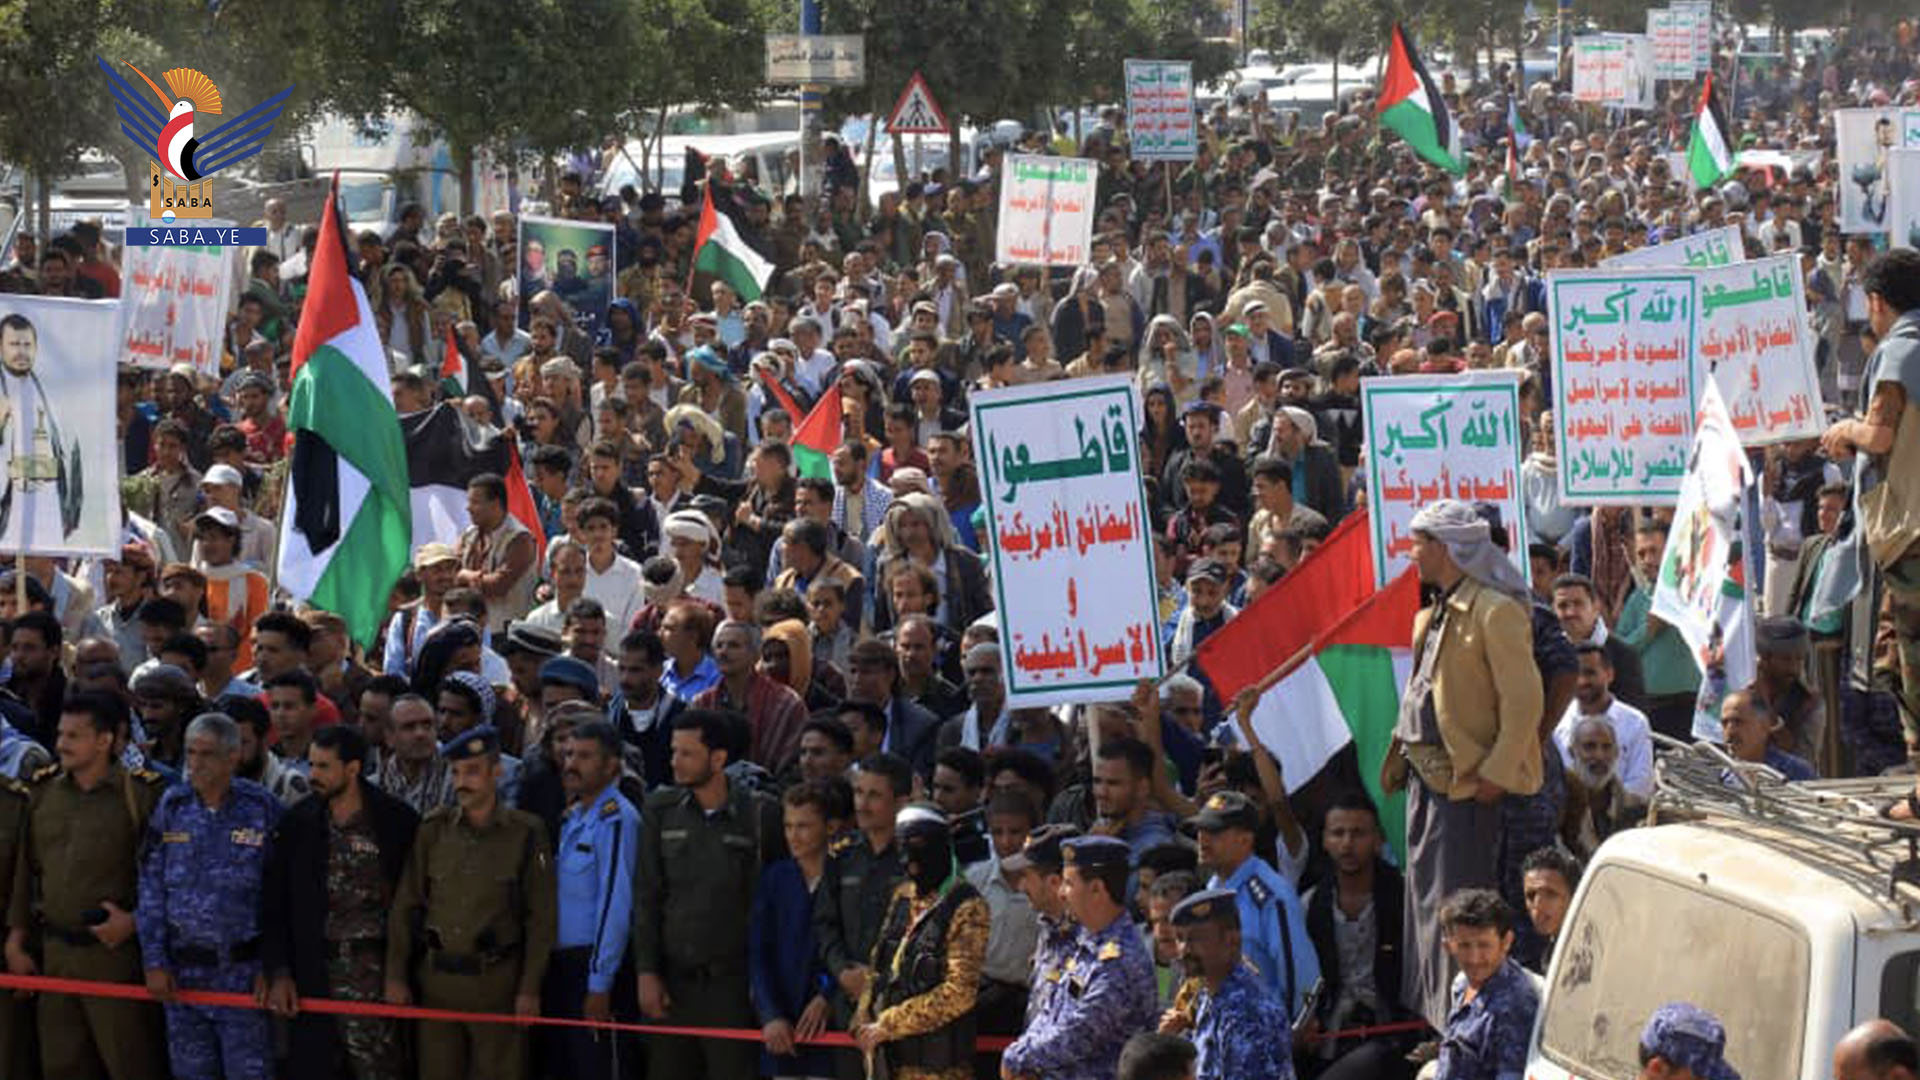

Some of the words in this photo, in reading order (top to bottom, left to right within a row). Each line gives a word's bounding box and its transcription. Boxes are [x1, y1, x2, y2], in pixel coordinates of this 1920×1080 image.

[1684, 242, 1731, 267] قاط
[1563, 283, 1637, 336] أكبر
[1640, 287, 1687, 323] الله
[1702, 265, 1792, 317] قاطعو
[1634, 337, 1685, 365] الموت
[1635, 377, 1686, 404] الموت
[1750, 363, 1759, 391] و
[1380, 394, 1453, 465] أكبر
[1461, 400, 1512, 448] الله
[1567, 411, 1614, 442] اليهود
[1620, 413, 1643, 442] على
[1648, 411, 1689, 437] اللعنة
[988, 404, 1131, 506] قاطعوا
[1570, 447, 1633, 489] للإسلام
[1640, 444, 1686, 486] لنصر
[1457, 469, 1516, 501] الموت
[998, 500, 1070, 562] الأمريكية
[1076, 501, 1140, 557] البضائع
[1066, 577, 1078, 617] و
[1014, 622, 1156, 678] الإسرائيلية
